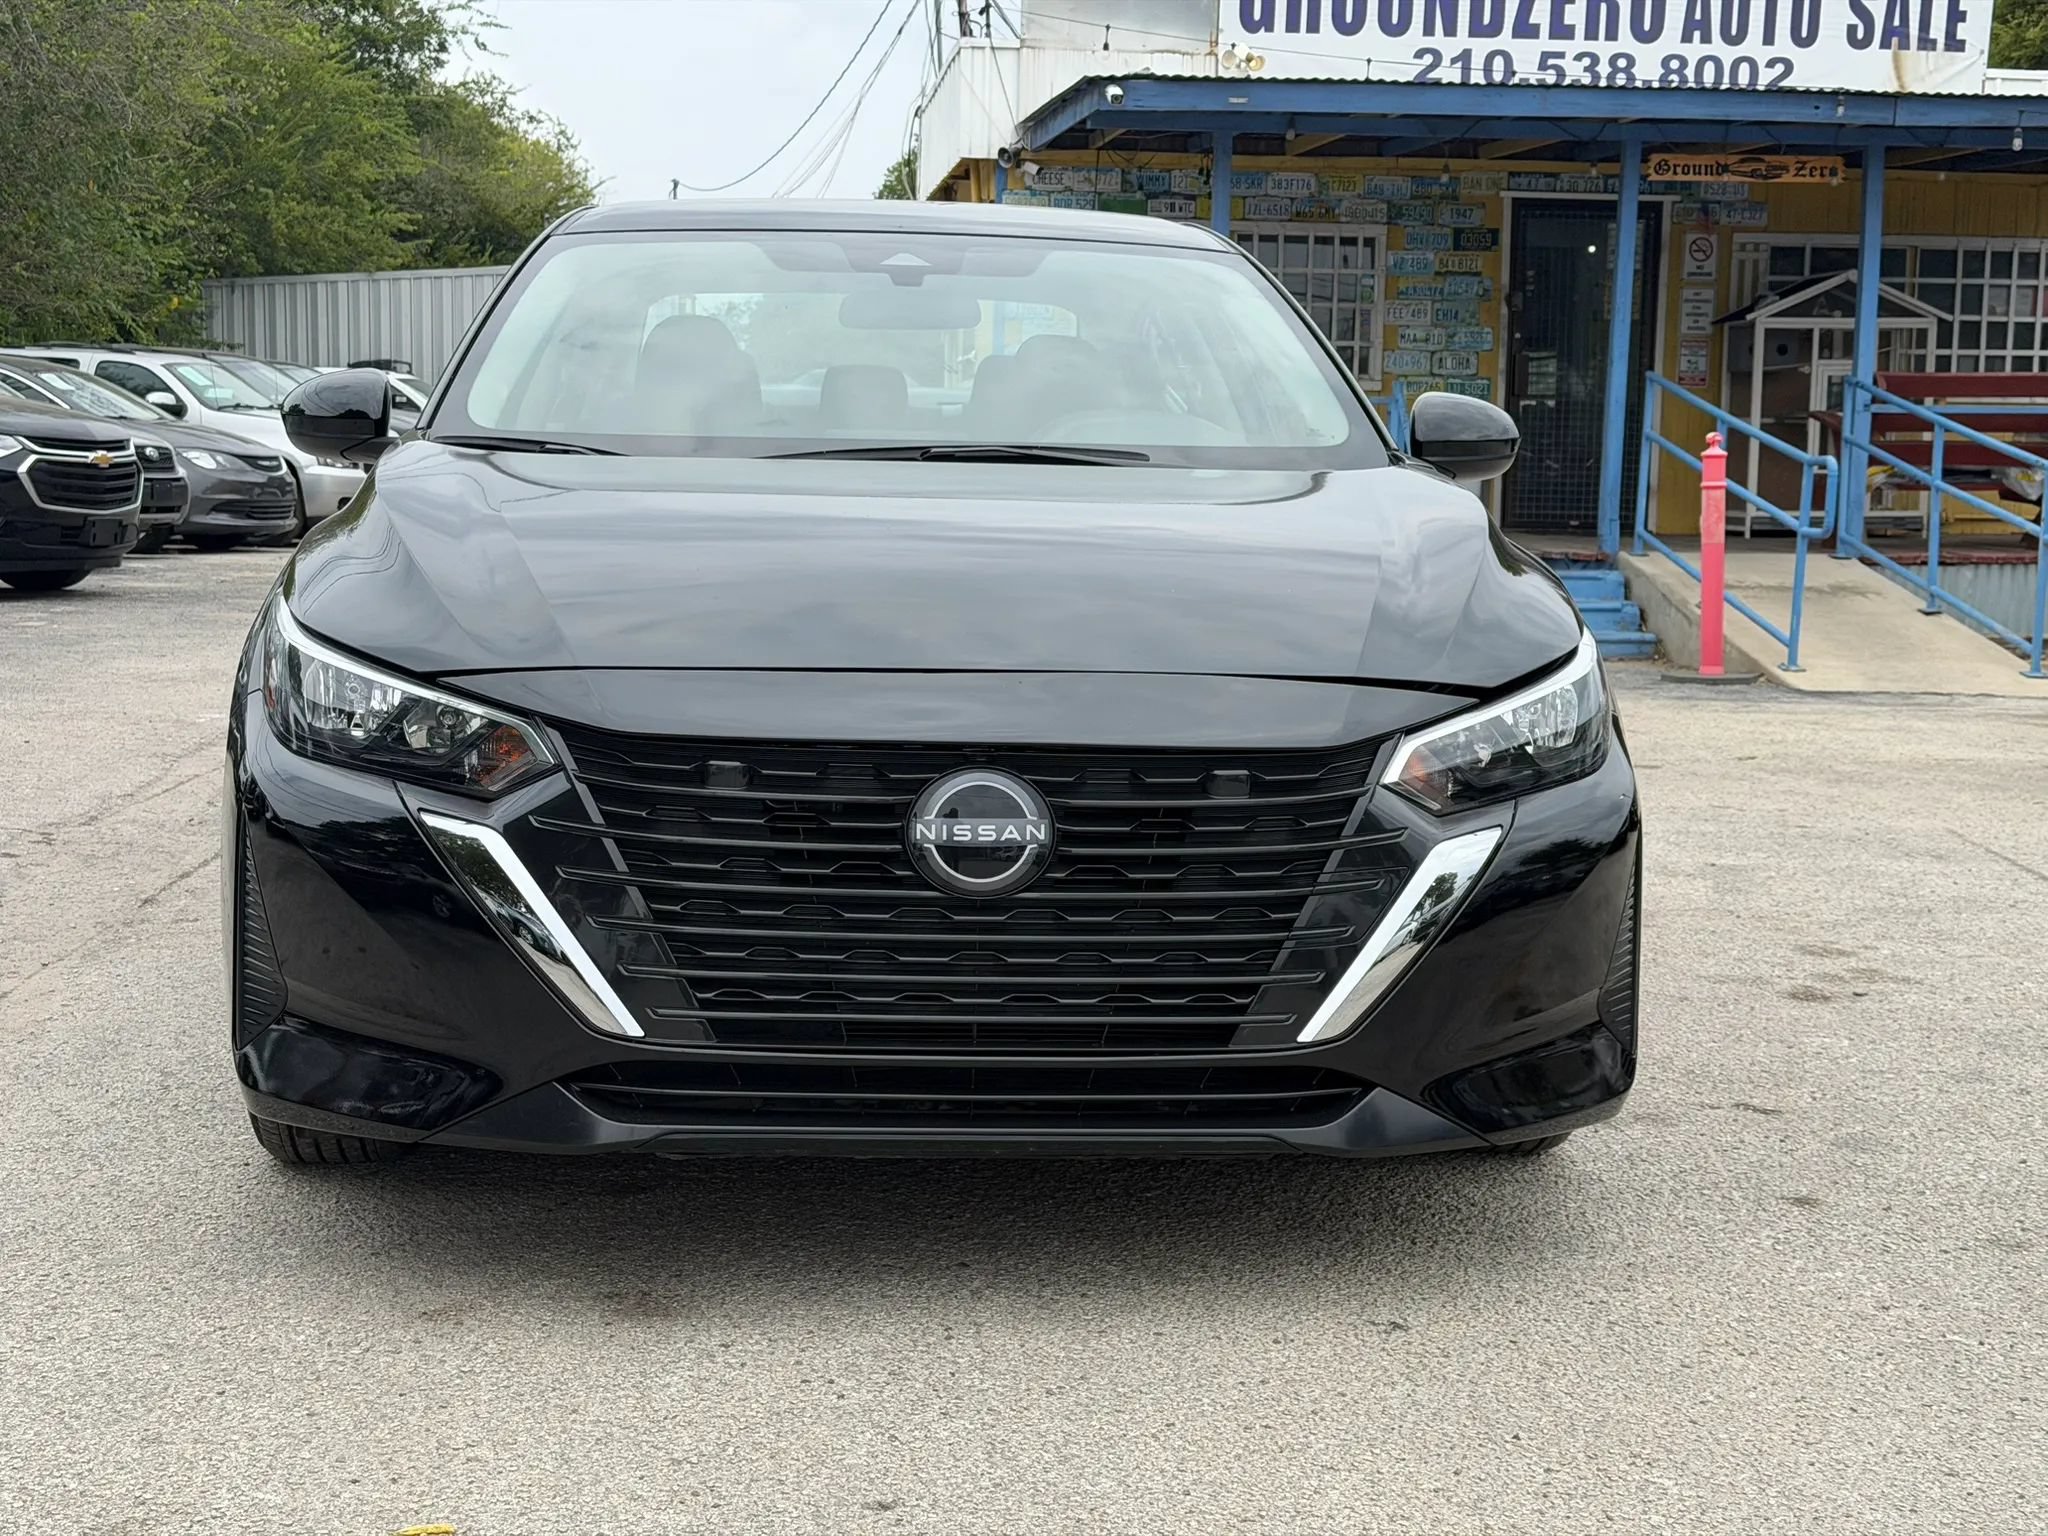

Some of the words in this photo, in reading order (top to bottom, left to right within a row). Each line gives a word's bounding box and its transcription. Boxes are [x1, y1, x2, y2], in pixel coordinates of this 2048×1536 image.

[1846, 0, 1968, 53] SALE
[1653, 158, 1727, 177] Ground
[1791, 160, 1838, 178] Zer
[1032, 171, 1065, 186] CHEESE
[1271, 178, 1312, 191] 383F176
[1449, 207, 1473, 220] 1947
[1438, 356, 1471, 371] ALOHA
[916, 823, 1046, 842] NISSAN
